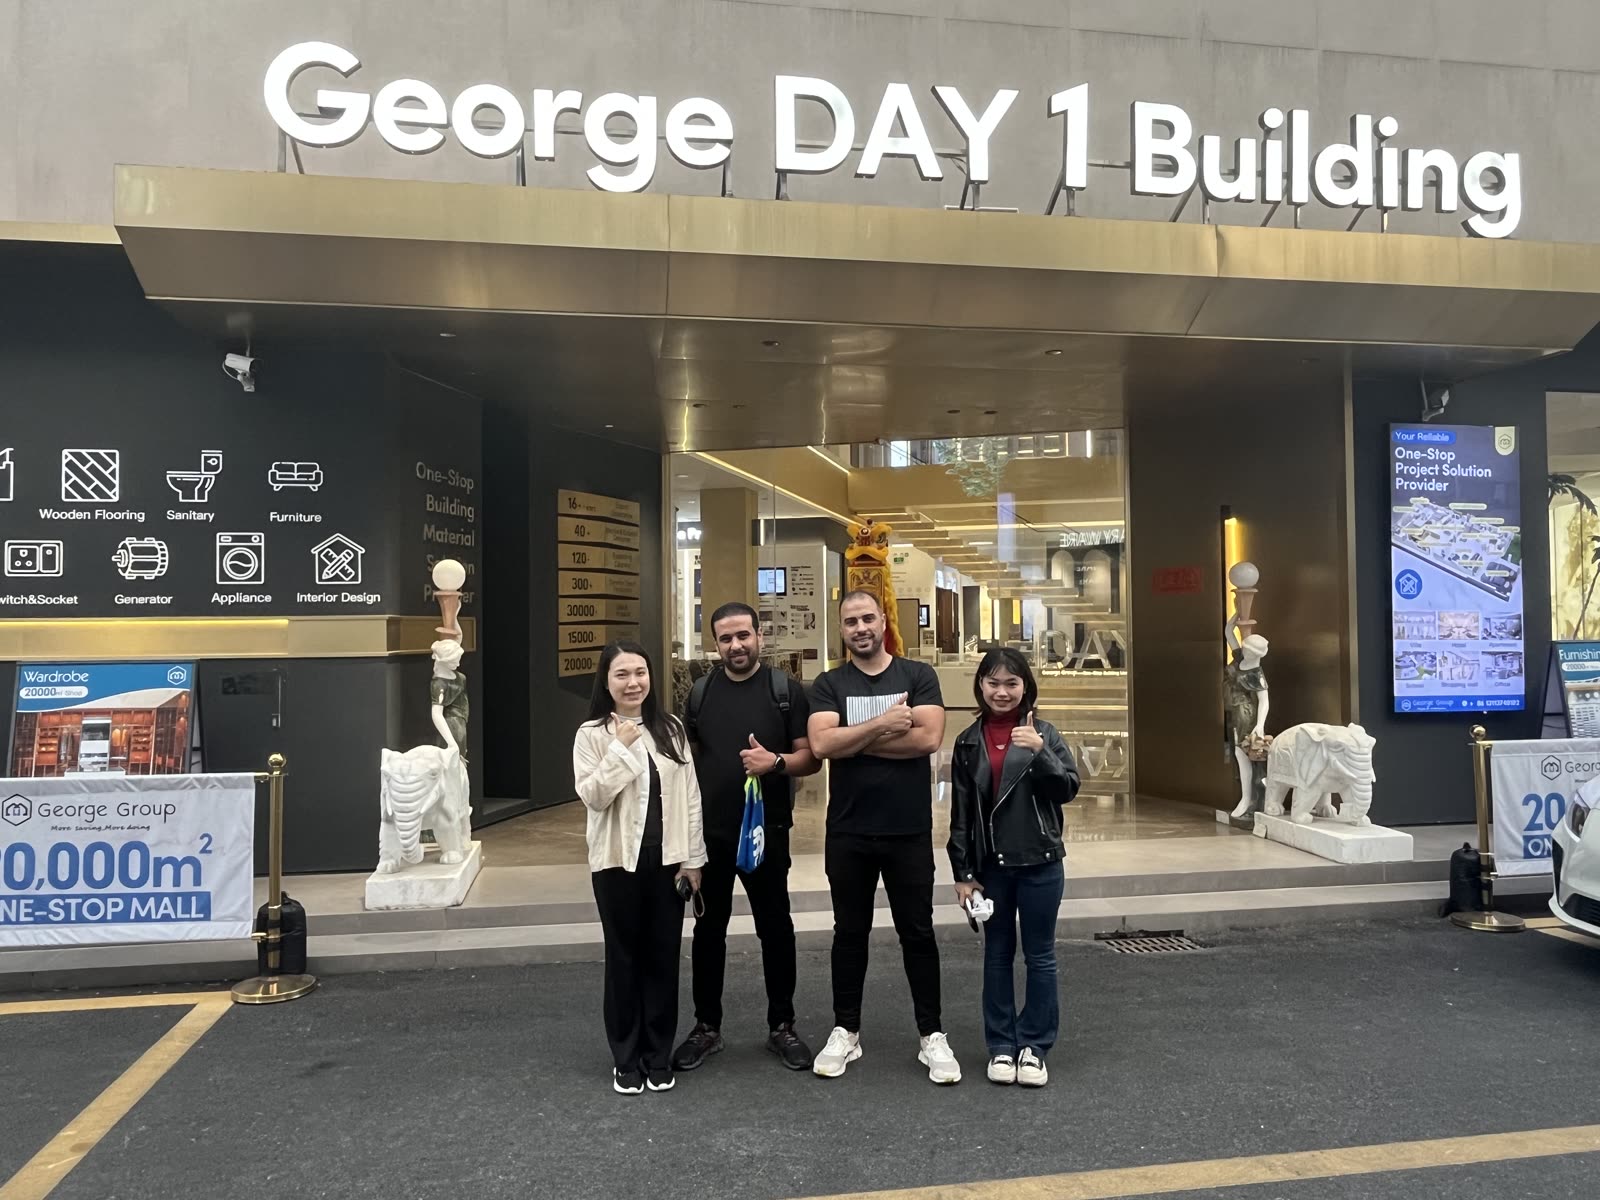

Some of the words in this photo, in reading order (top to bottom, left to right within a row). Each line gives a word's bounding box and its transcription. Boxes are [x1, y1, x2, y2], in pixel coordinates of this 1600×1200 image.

[264, 41, 735, 193] George
[774, 74, 1020, 184] DAY
[1047, 82, 1089, 192] 1
[1131, 101, 1521, 238] Building
[1395, 431, 1416, 441] Your
[1417, 432, 1450, 443] Reliable
[1395, 447, 1456, 466] One-Stop
[416, 461, 475, 494] One-Stop
[1396, 462, 1440, 481] Project
[1443, 464, 1492, 478] Solution
[1395, 478, 1449, 492] Provider
[39, 508, 91, 520] Wooden
[95, 509, 145, 522] Flooring
[166, 509, 215, 522] Sanitary
[426, 494, 475, 523] Building
[270, 511, 322, 523] Furniture
[423, 523, 475, 547] Material
[0, 594, 79, 605] witch&Socket
[114, 593, 173, 605] Generator
[211, 591, 272, 604] Appliance
[297, 592, 338, 603] Interior
[342, 592, 381, 604] Design
[1558, 647, 1600, 660] Furnishin
[24, 670, 89, 683] Wardrobe
[38, 802, 108, 823] George
[116, 802, 176, 823] Group
[0, 833, 213, 891] 0,000m²
[0, 898, 124, 922] NE-STOP
[129, 896, 204, 919] MALL
